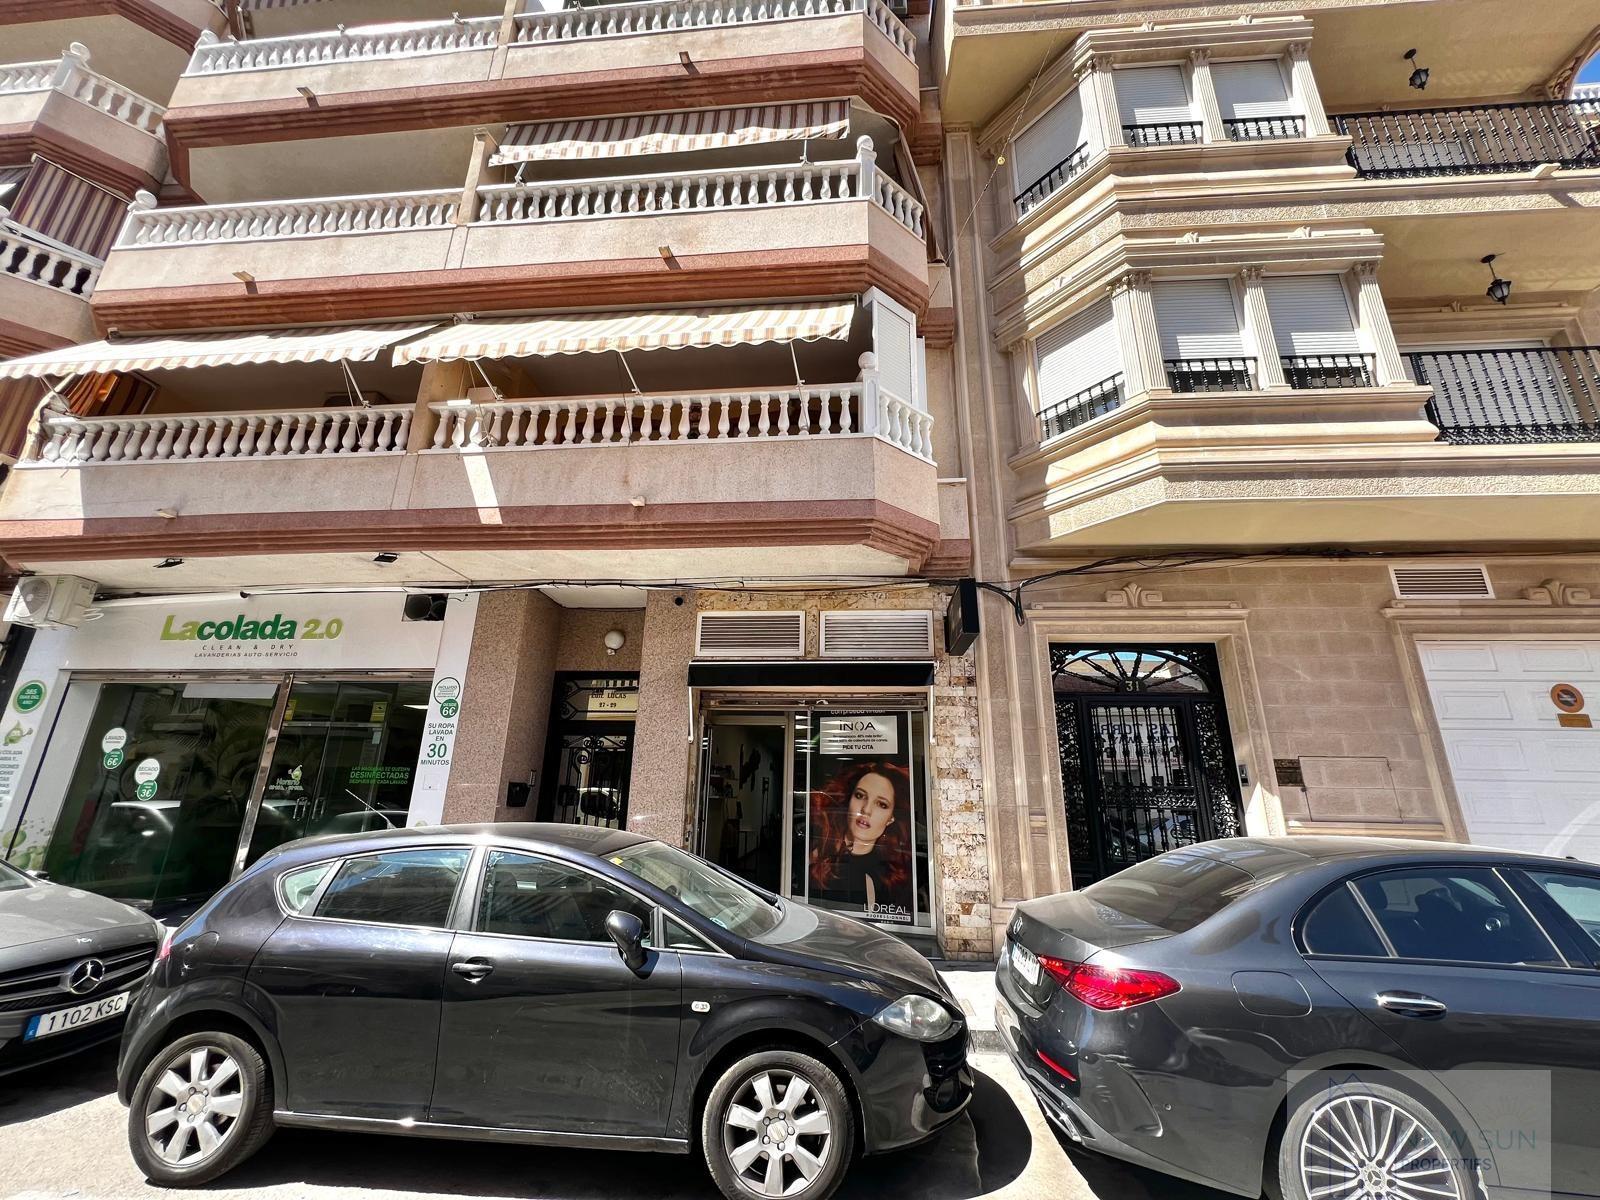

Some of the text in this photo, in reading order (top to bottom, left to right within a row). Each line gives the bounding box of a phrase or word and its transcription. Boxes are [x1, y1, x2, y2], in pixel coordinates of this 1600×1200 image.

[301, 617, 344, 640] 2.0
[1125, 680, 1140, 692] 31
[442, 706, 456, 716] 6€
[426, 743, 448, 758] 30
[107, 757, 119, 766] 6€
[350, 771, 409, 779] DESINFECTADAS
[140, 788, 153, 798] 3€
[49, 996, 123, 1032] 1102 KSC
